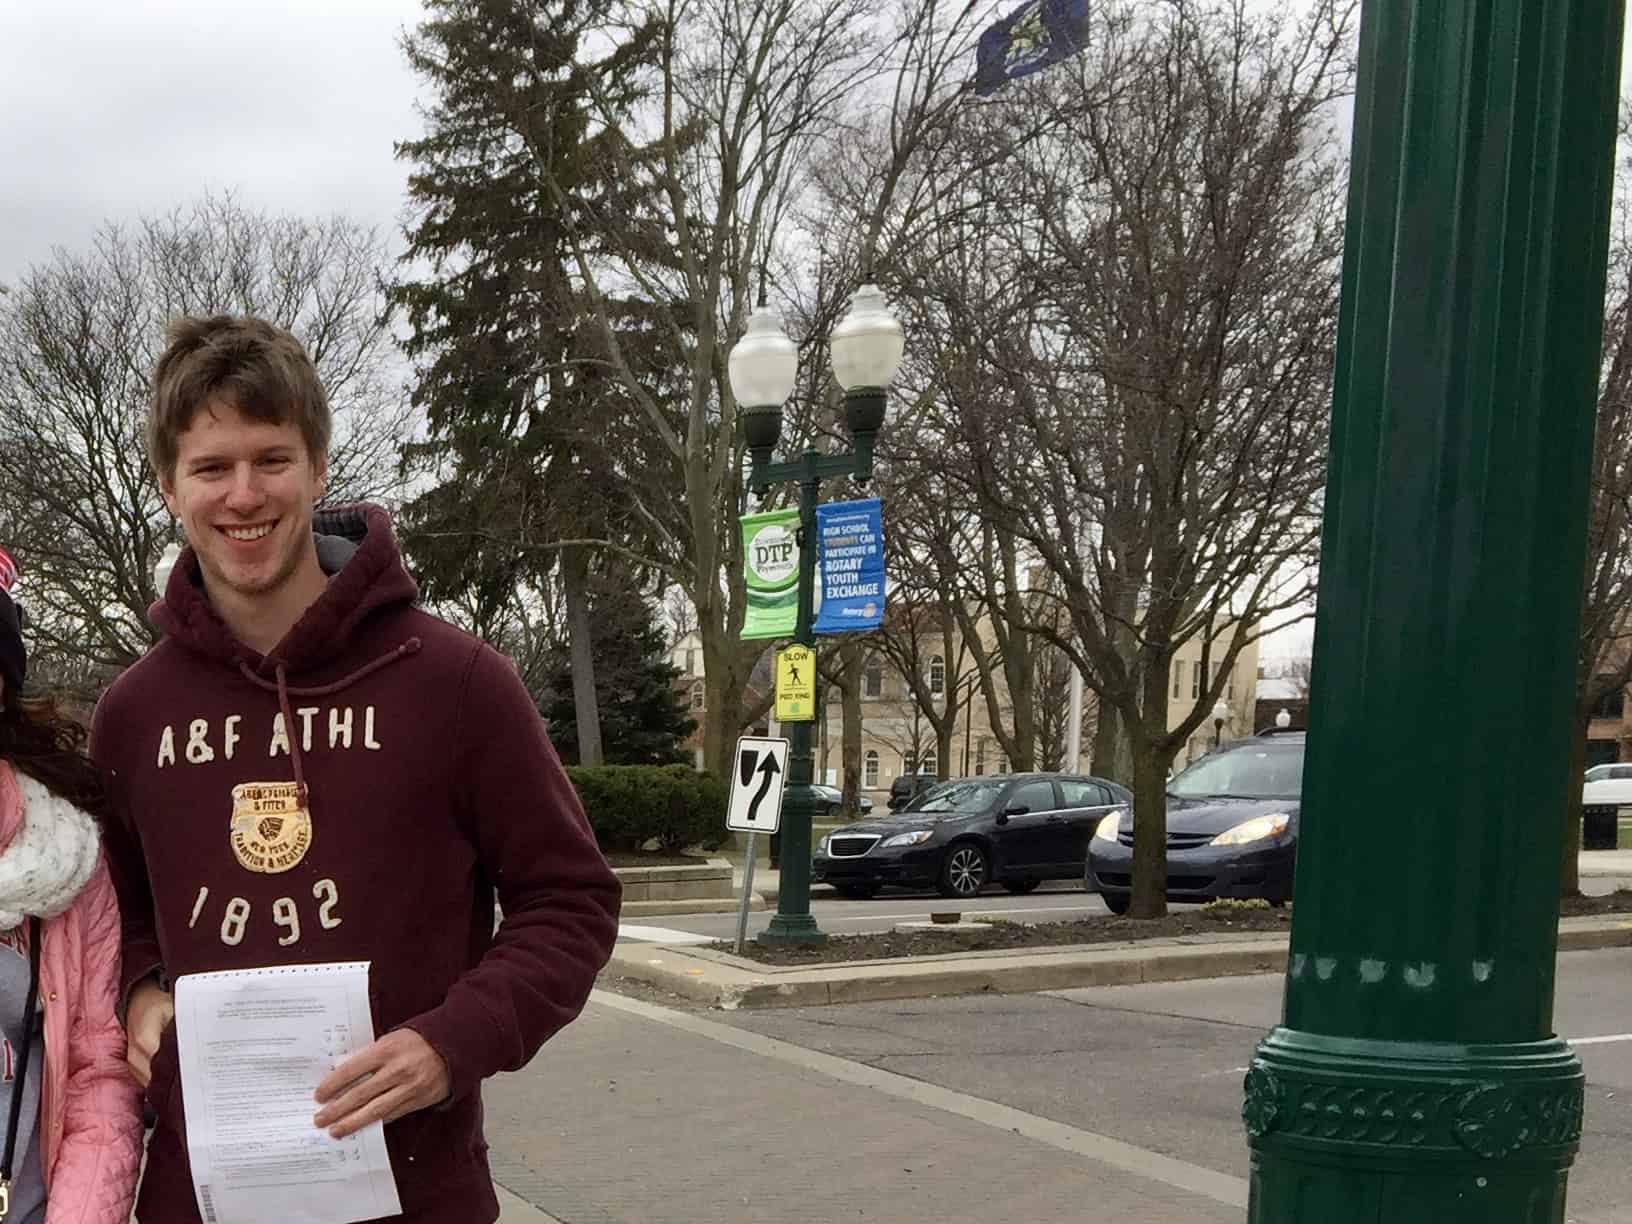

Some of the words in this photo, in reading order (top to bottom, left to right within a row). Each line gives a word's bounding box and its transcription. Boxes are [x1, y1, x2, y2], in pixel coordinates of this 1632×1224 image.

[755, 542, 793, 564] DTP
[825, 558, 863, 573] ROTARY
[826, 572, 859, 585] YOUTH
[826, 583, 879, 599] EXCHANGE
[157, 715, 242, 768] A&F
[269, 705, 381, 757] ATHL
[188, 879, 342, 946] 1892
